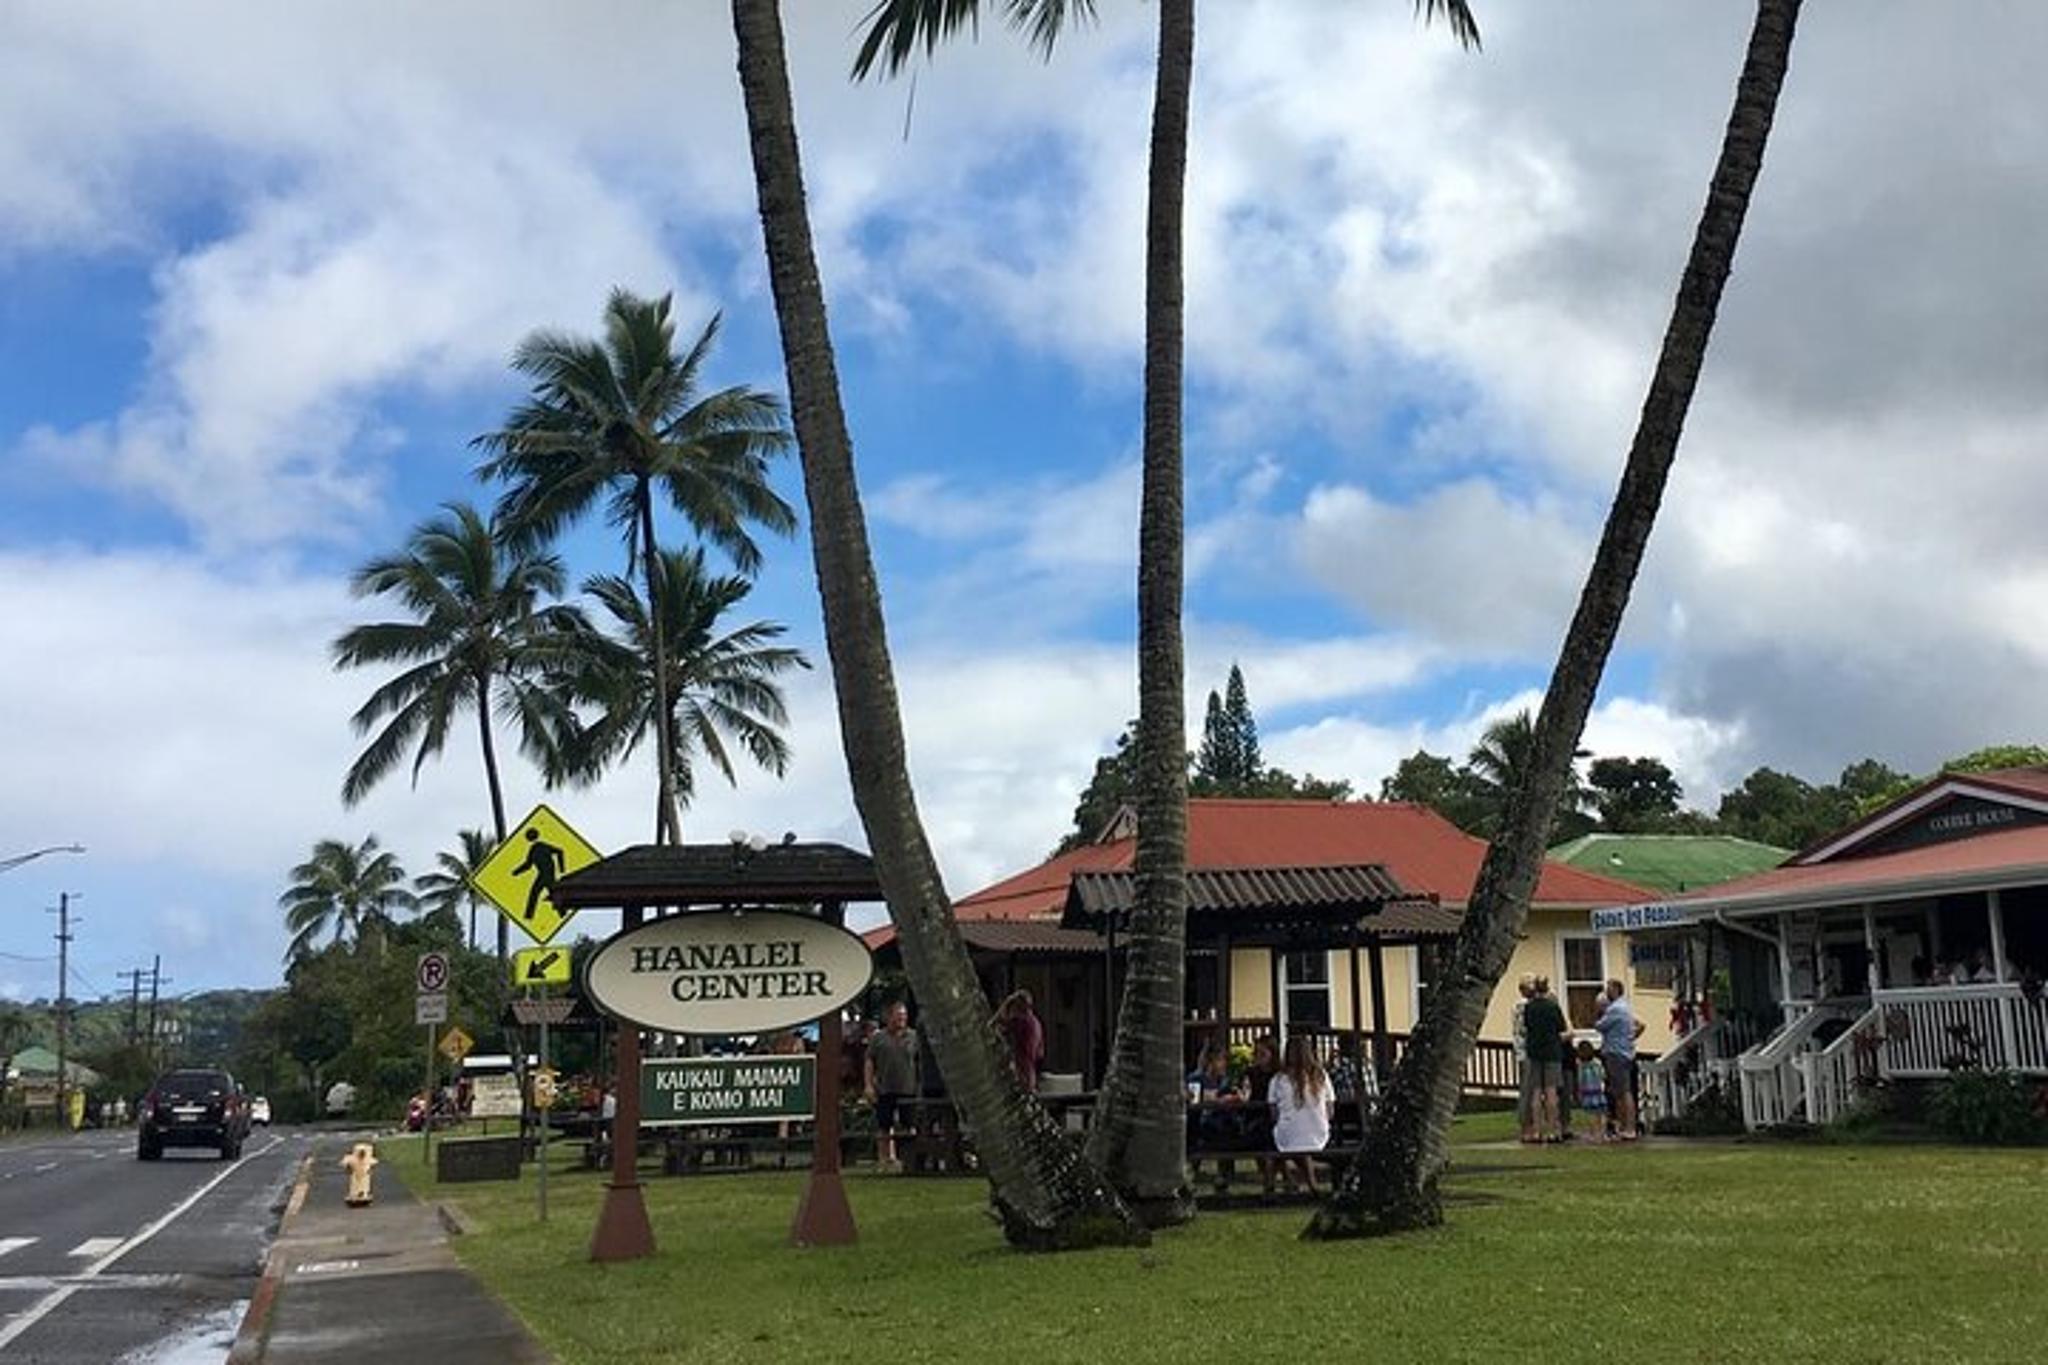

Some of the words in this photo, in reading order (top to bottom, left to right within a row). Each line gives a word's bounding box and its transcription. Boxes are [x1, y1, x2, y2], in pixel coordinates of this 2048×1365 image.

[631, 941, 804, 973] HANALEI
[671, 971, 832, 1001] CENTER
[656, 1068, 724, 1090] KAUKAU
[734, 1067, 801, 1087] MAIMAI
[673, 1092, 685, 1111] E
[690, 1090, 743, 1110] KOMO
[750, 1089, 783, 1107] MAI
